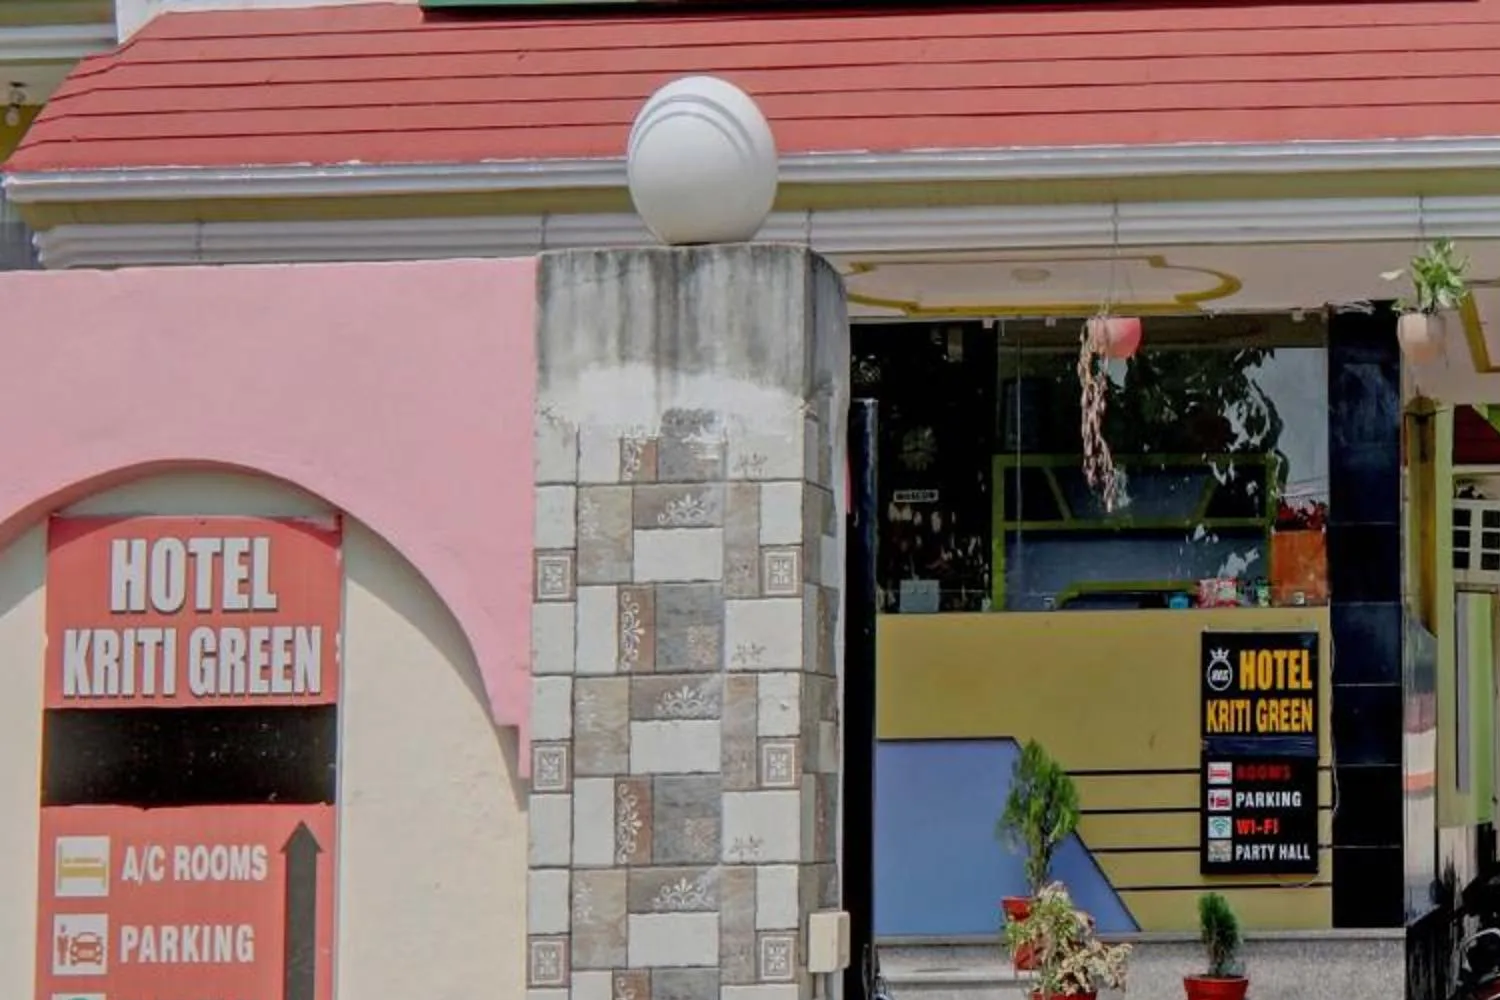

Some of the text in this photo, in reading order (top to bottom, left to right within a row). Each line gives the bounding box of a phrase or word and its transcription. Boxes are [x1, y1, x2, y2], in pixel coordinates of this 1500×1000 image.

[110, 537, 278, 613] HOTEL
[63, 625, 323, 698] KRITI GREEN
[1239, 649, 1313, 691] HOTEL
[1206, 698, 1314, 733] KRITI GREEN
[1235, 764, 1292, 781] ROOMS
[1235, 791, 1303, 808] PARKING
[1236, 818, 1280, 835] WI-FI
[122, 845, 268, 887] A/C ROOMS
[1235, 844, 1311, 861] PARTY HALL
[120, 926, 255, 963] PARKING
